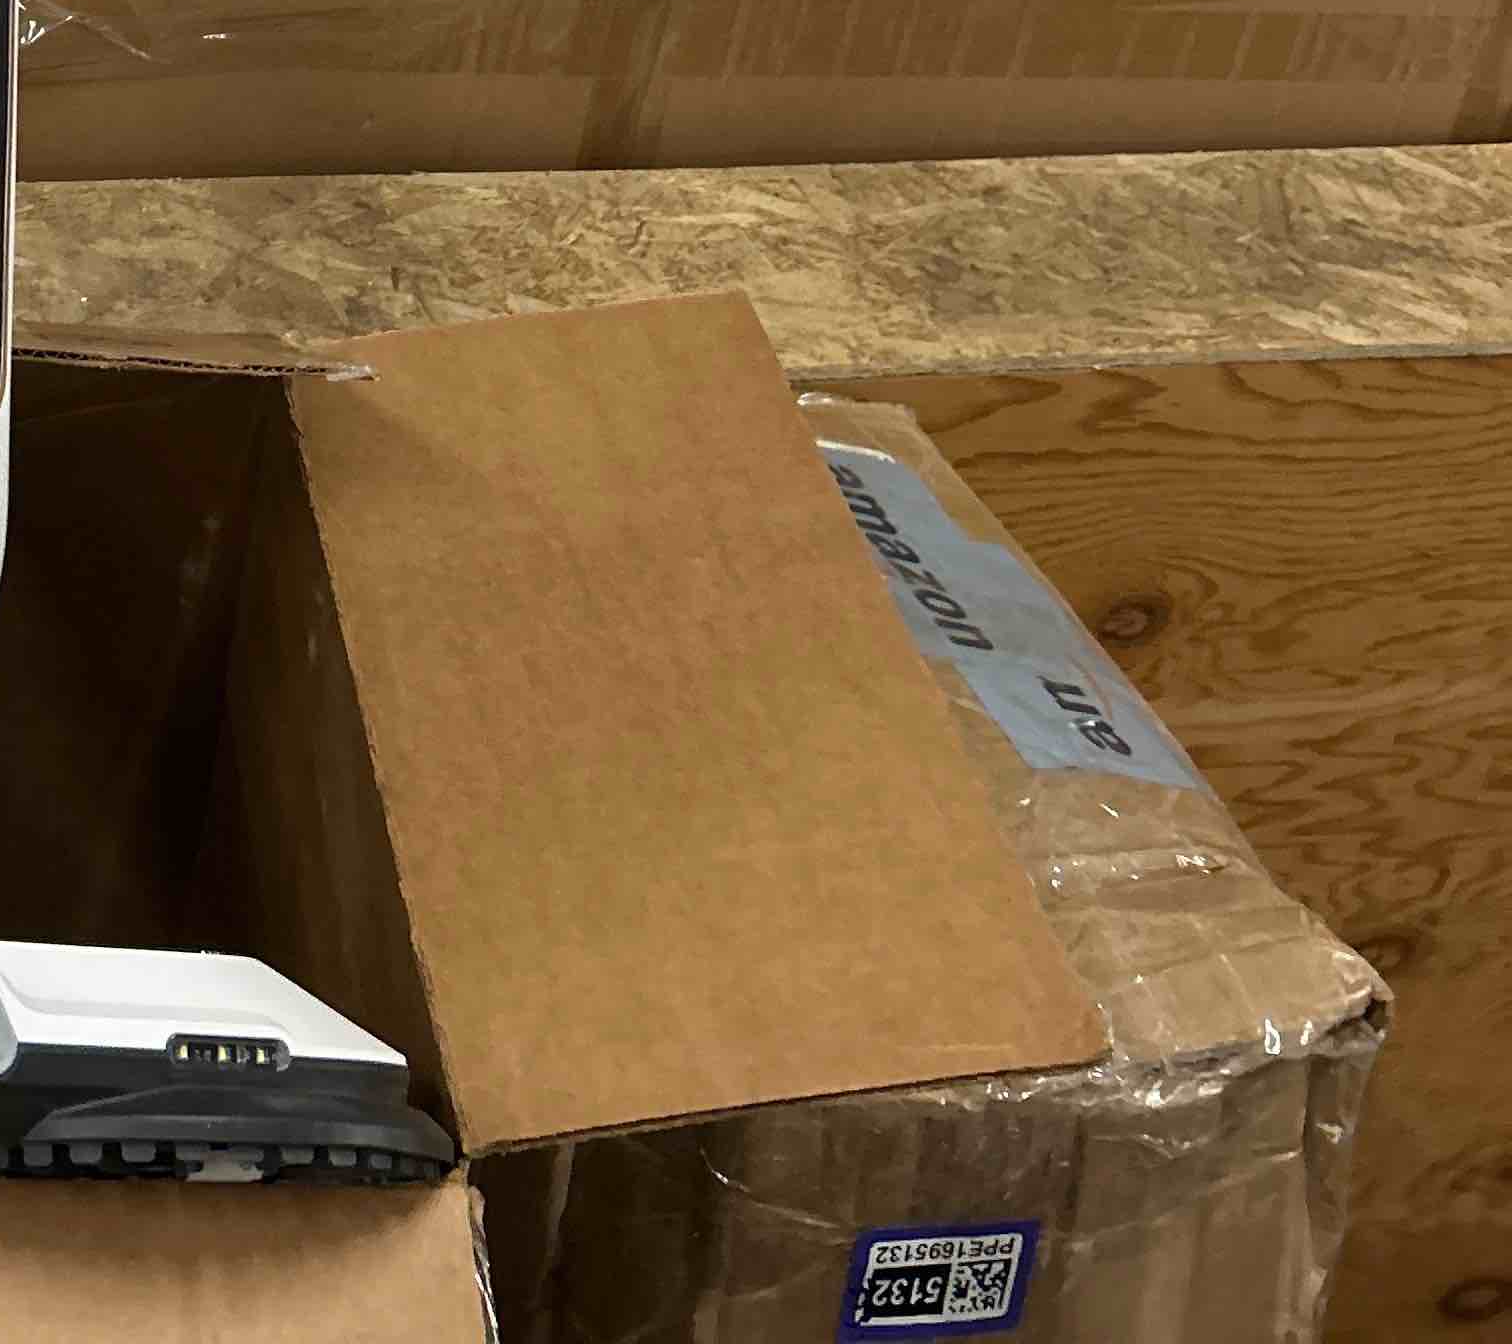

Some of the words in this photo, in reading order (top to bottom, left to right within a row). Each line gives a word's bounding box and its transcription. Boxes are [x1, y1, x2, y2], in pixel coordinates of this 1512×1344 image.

[828, 463, 994, 651] amazon
[875, 1237, 1016, 1265] PPE1695132
[872, 1276, 944, 1307] 5132
